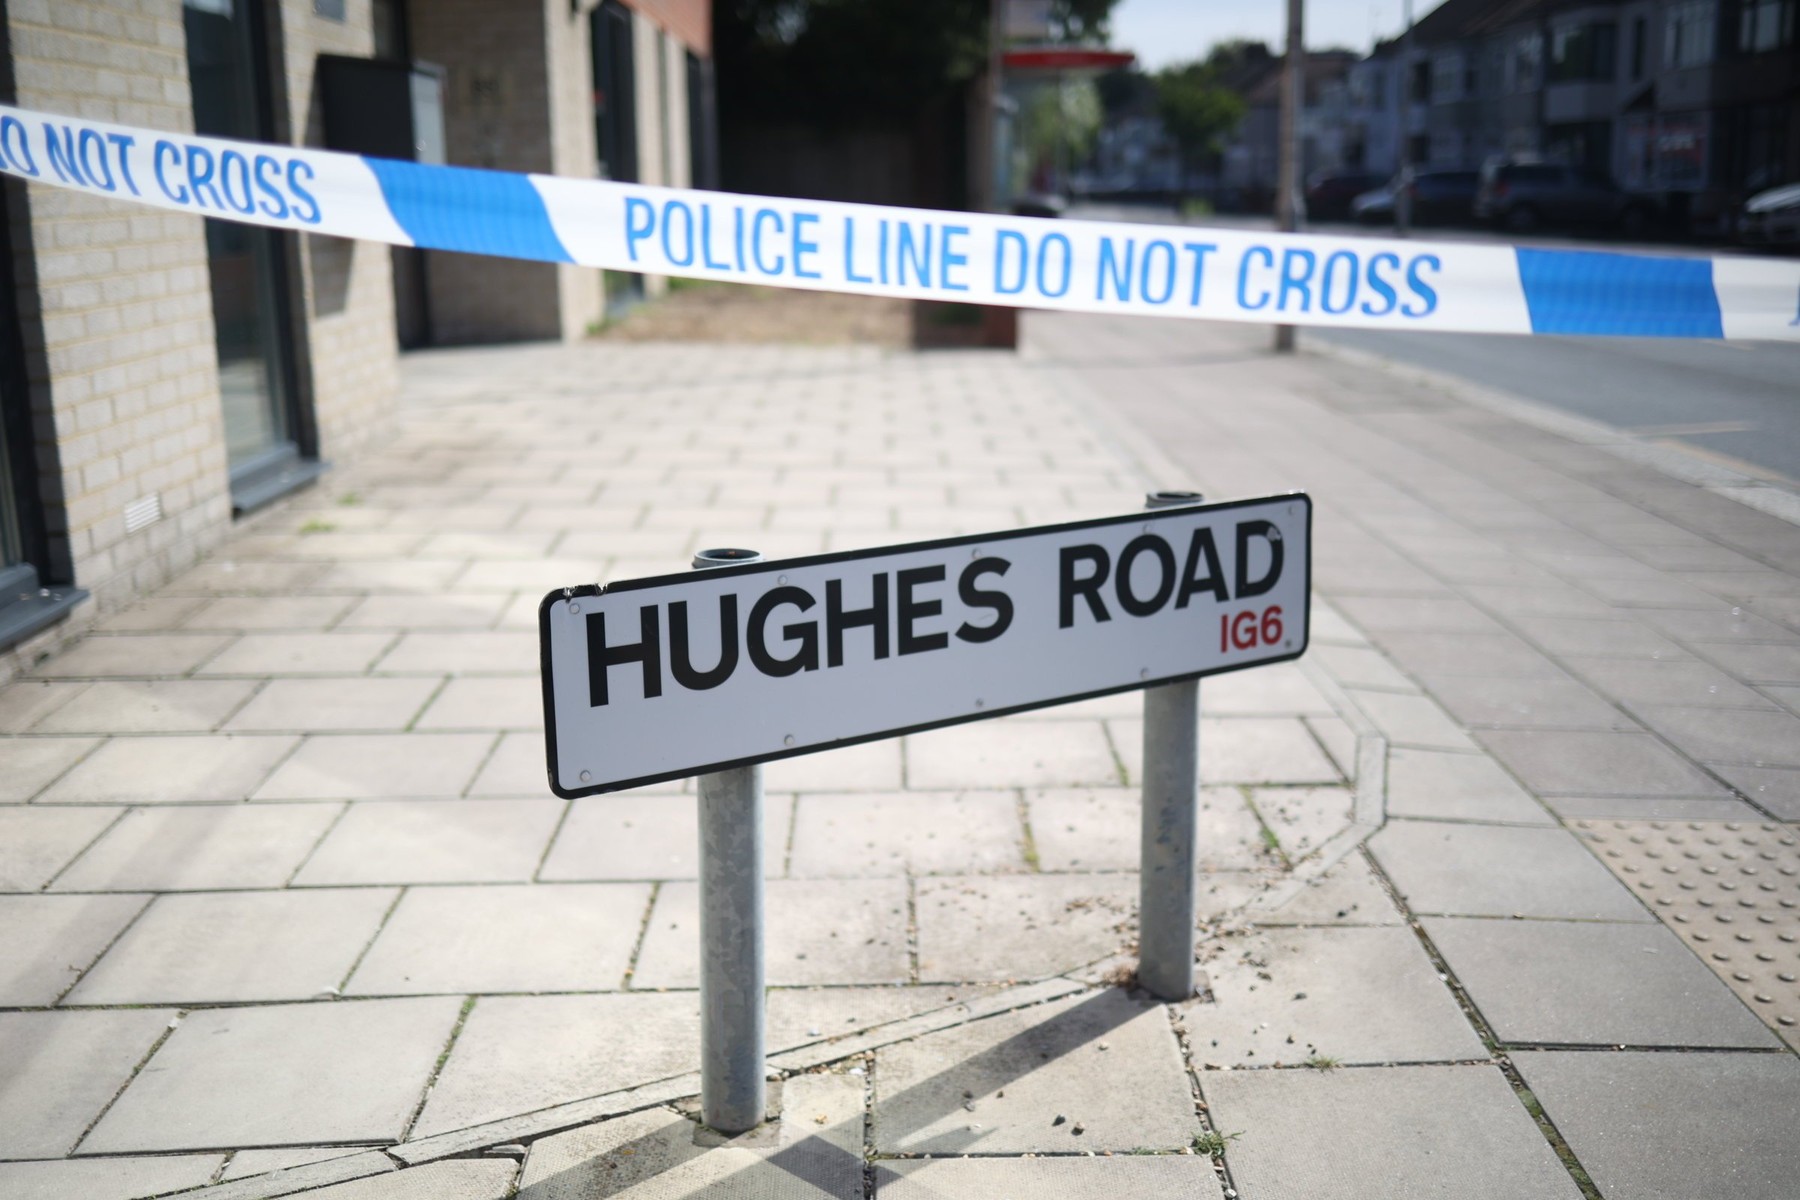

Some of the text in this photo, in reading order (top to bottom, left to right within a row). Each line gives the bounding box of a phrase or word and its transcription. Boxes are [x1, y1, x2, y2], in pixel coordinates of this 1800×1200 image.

[0, 116, 323, 225] O NOT CROSS
[624, 196, 1442, 320] POLICE LINE DO NOT CROSS
[586, 518, 1285, 708] HUGHES ROAD
[1219, 604, 1283, 654] IG6
